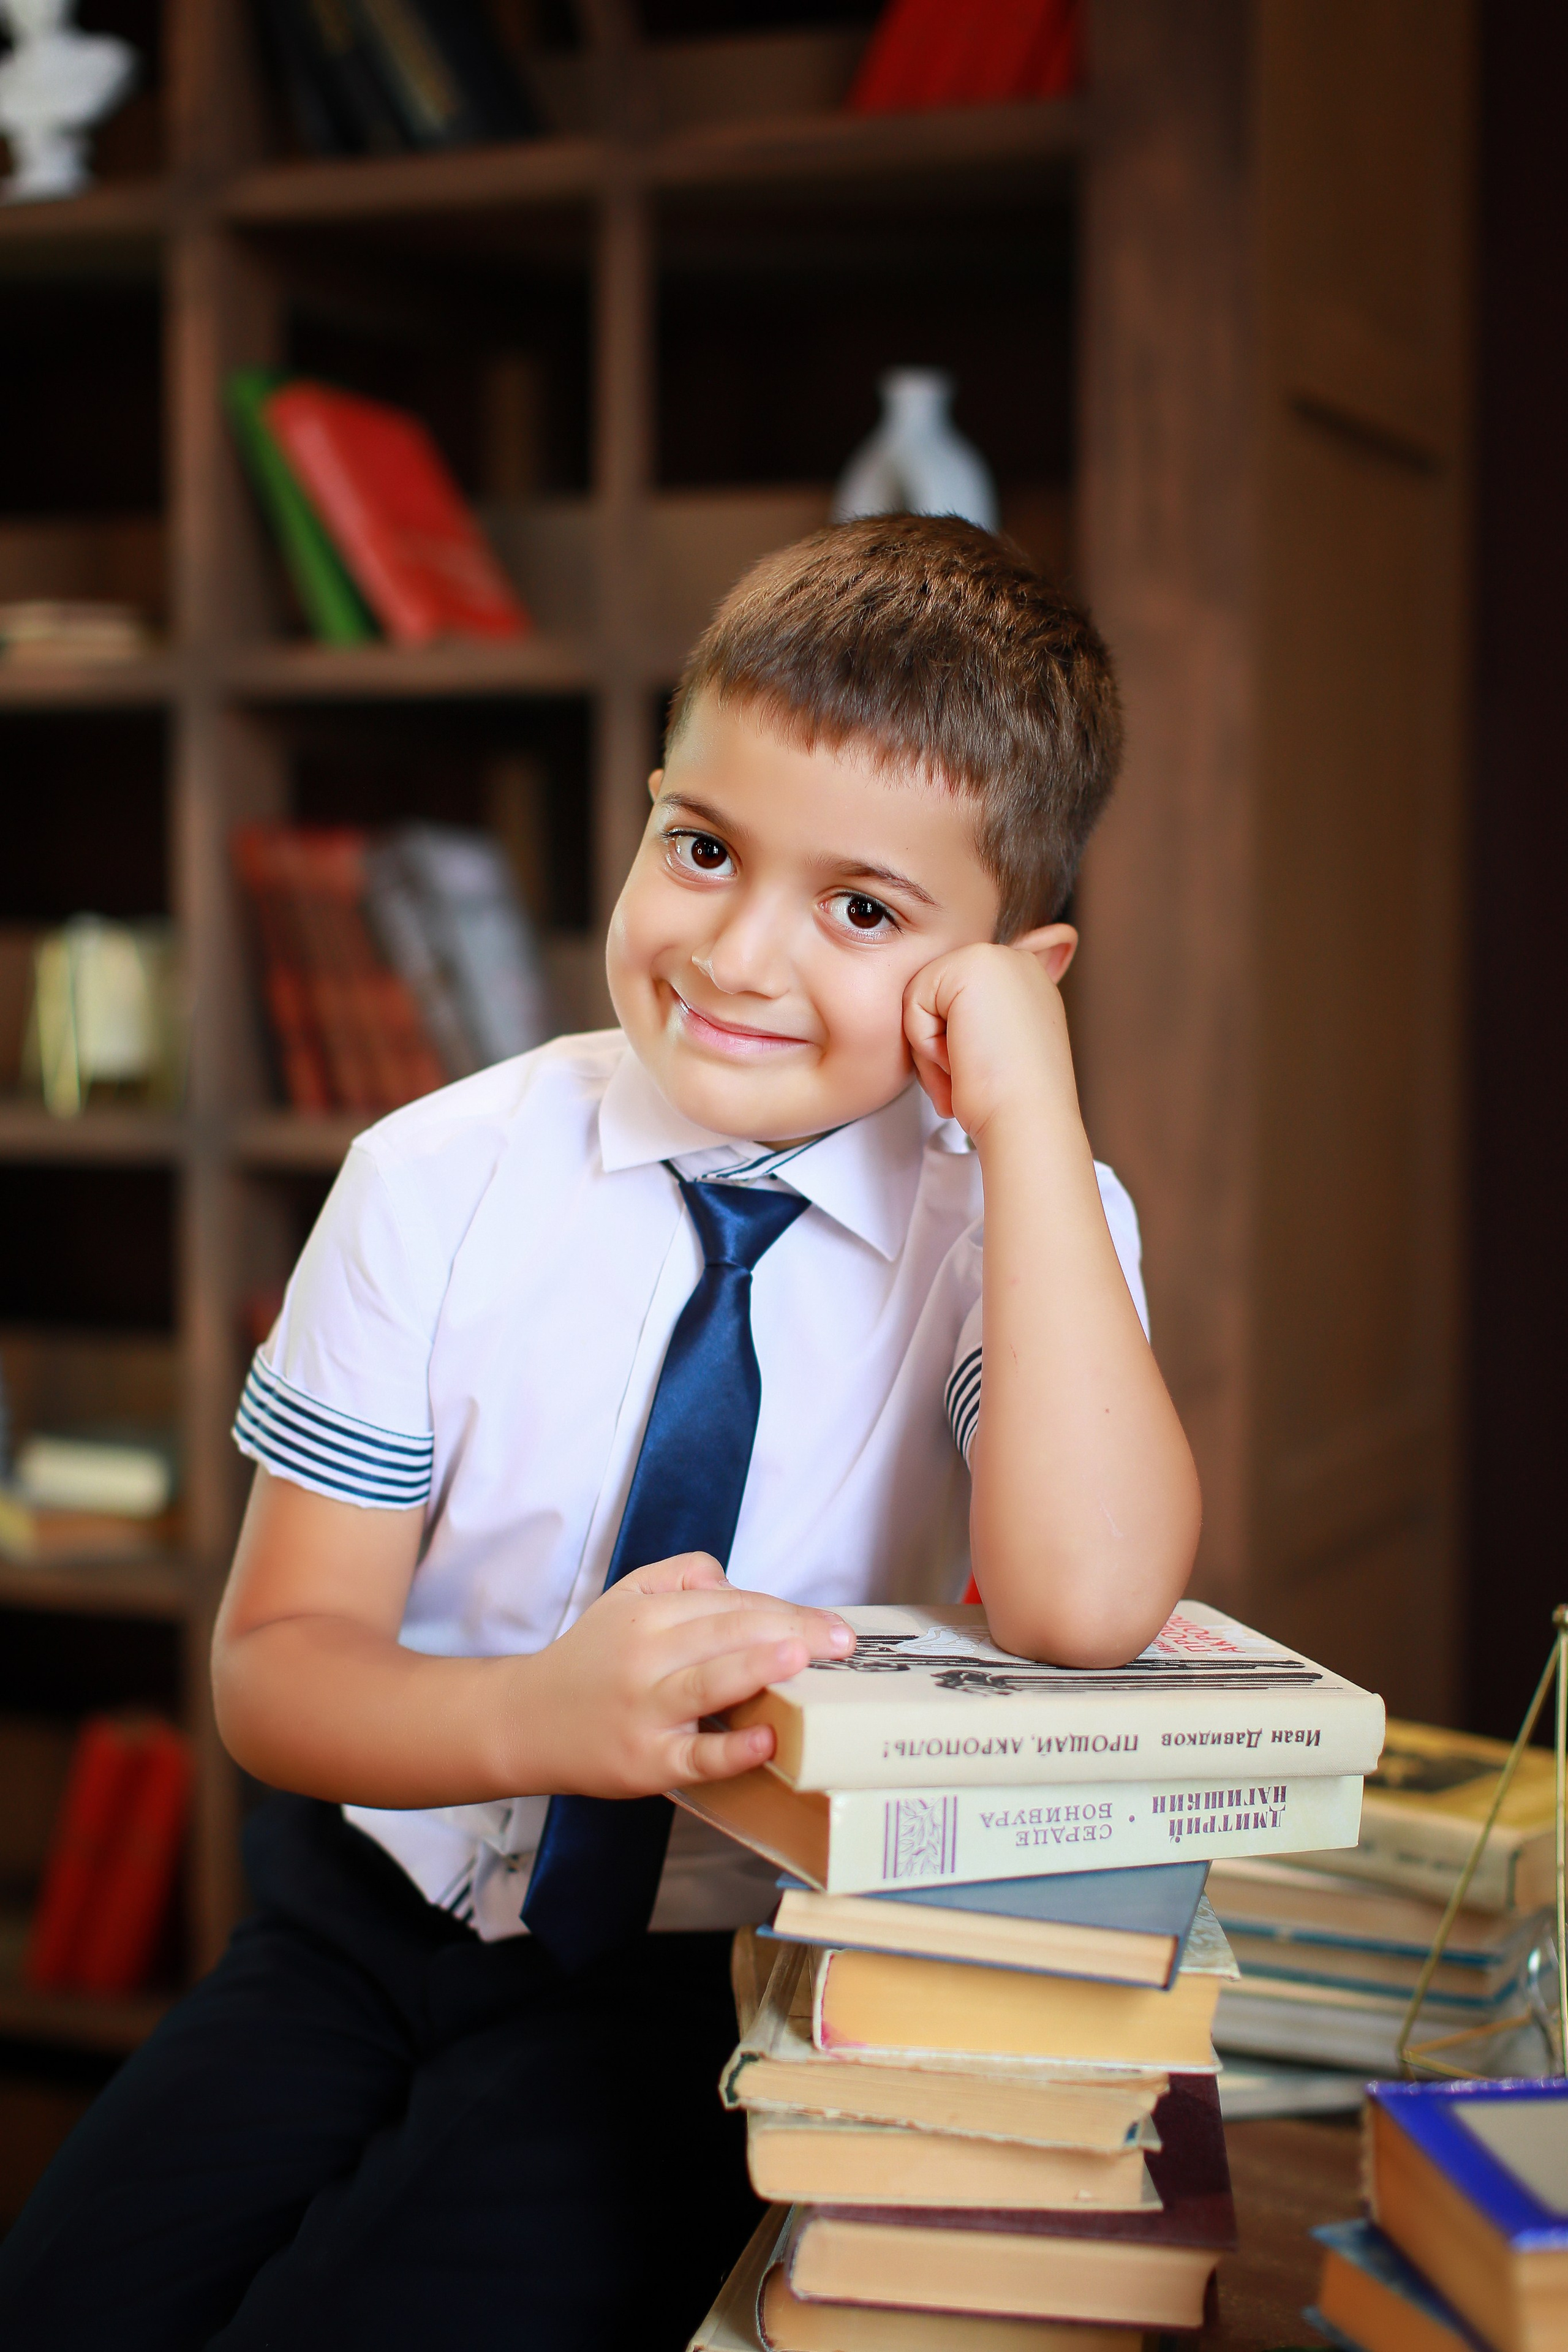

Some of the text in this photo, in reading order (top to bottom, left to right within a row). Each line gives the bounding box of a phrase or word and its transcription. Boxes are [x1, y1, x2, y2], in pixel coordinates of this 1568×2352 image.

[1153, 1639, 1179, 1653] Ива
[1161, 1624, 1213, 1652] ПРО
[1168, 1613, 1246, 1653] АКРОП
[883, 1728, 1322, 1758] Иван Давидков ПРОЩАЙ, АКРОПОЛЬ!
[1152, 1785, 1287, 1814] НАГИШКИН
[980, 1802, 1113, 1828] БОНИВУРА
[1168, 1804, 1286, 1843] ДМИТРИЙ
[1015, 1823, 1112, 1846] СЕРДЦЕ
